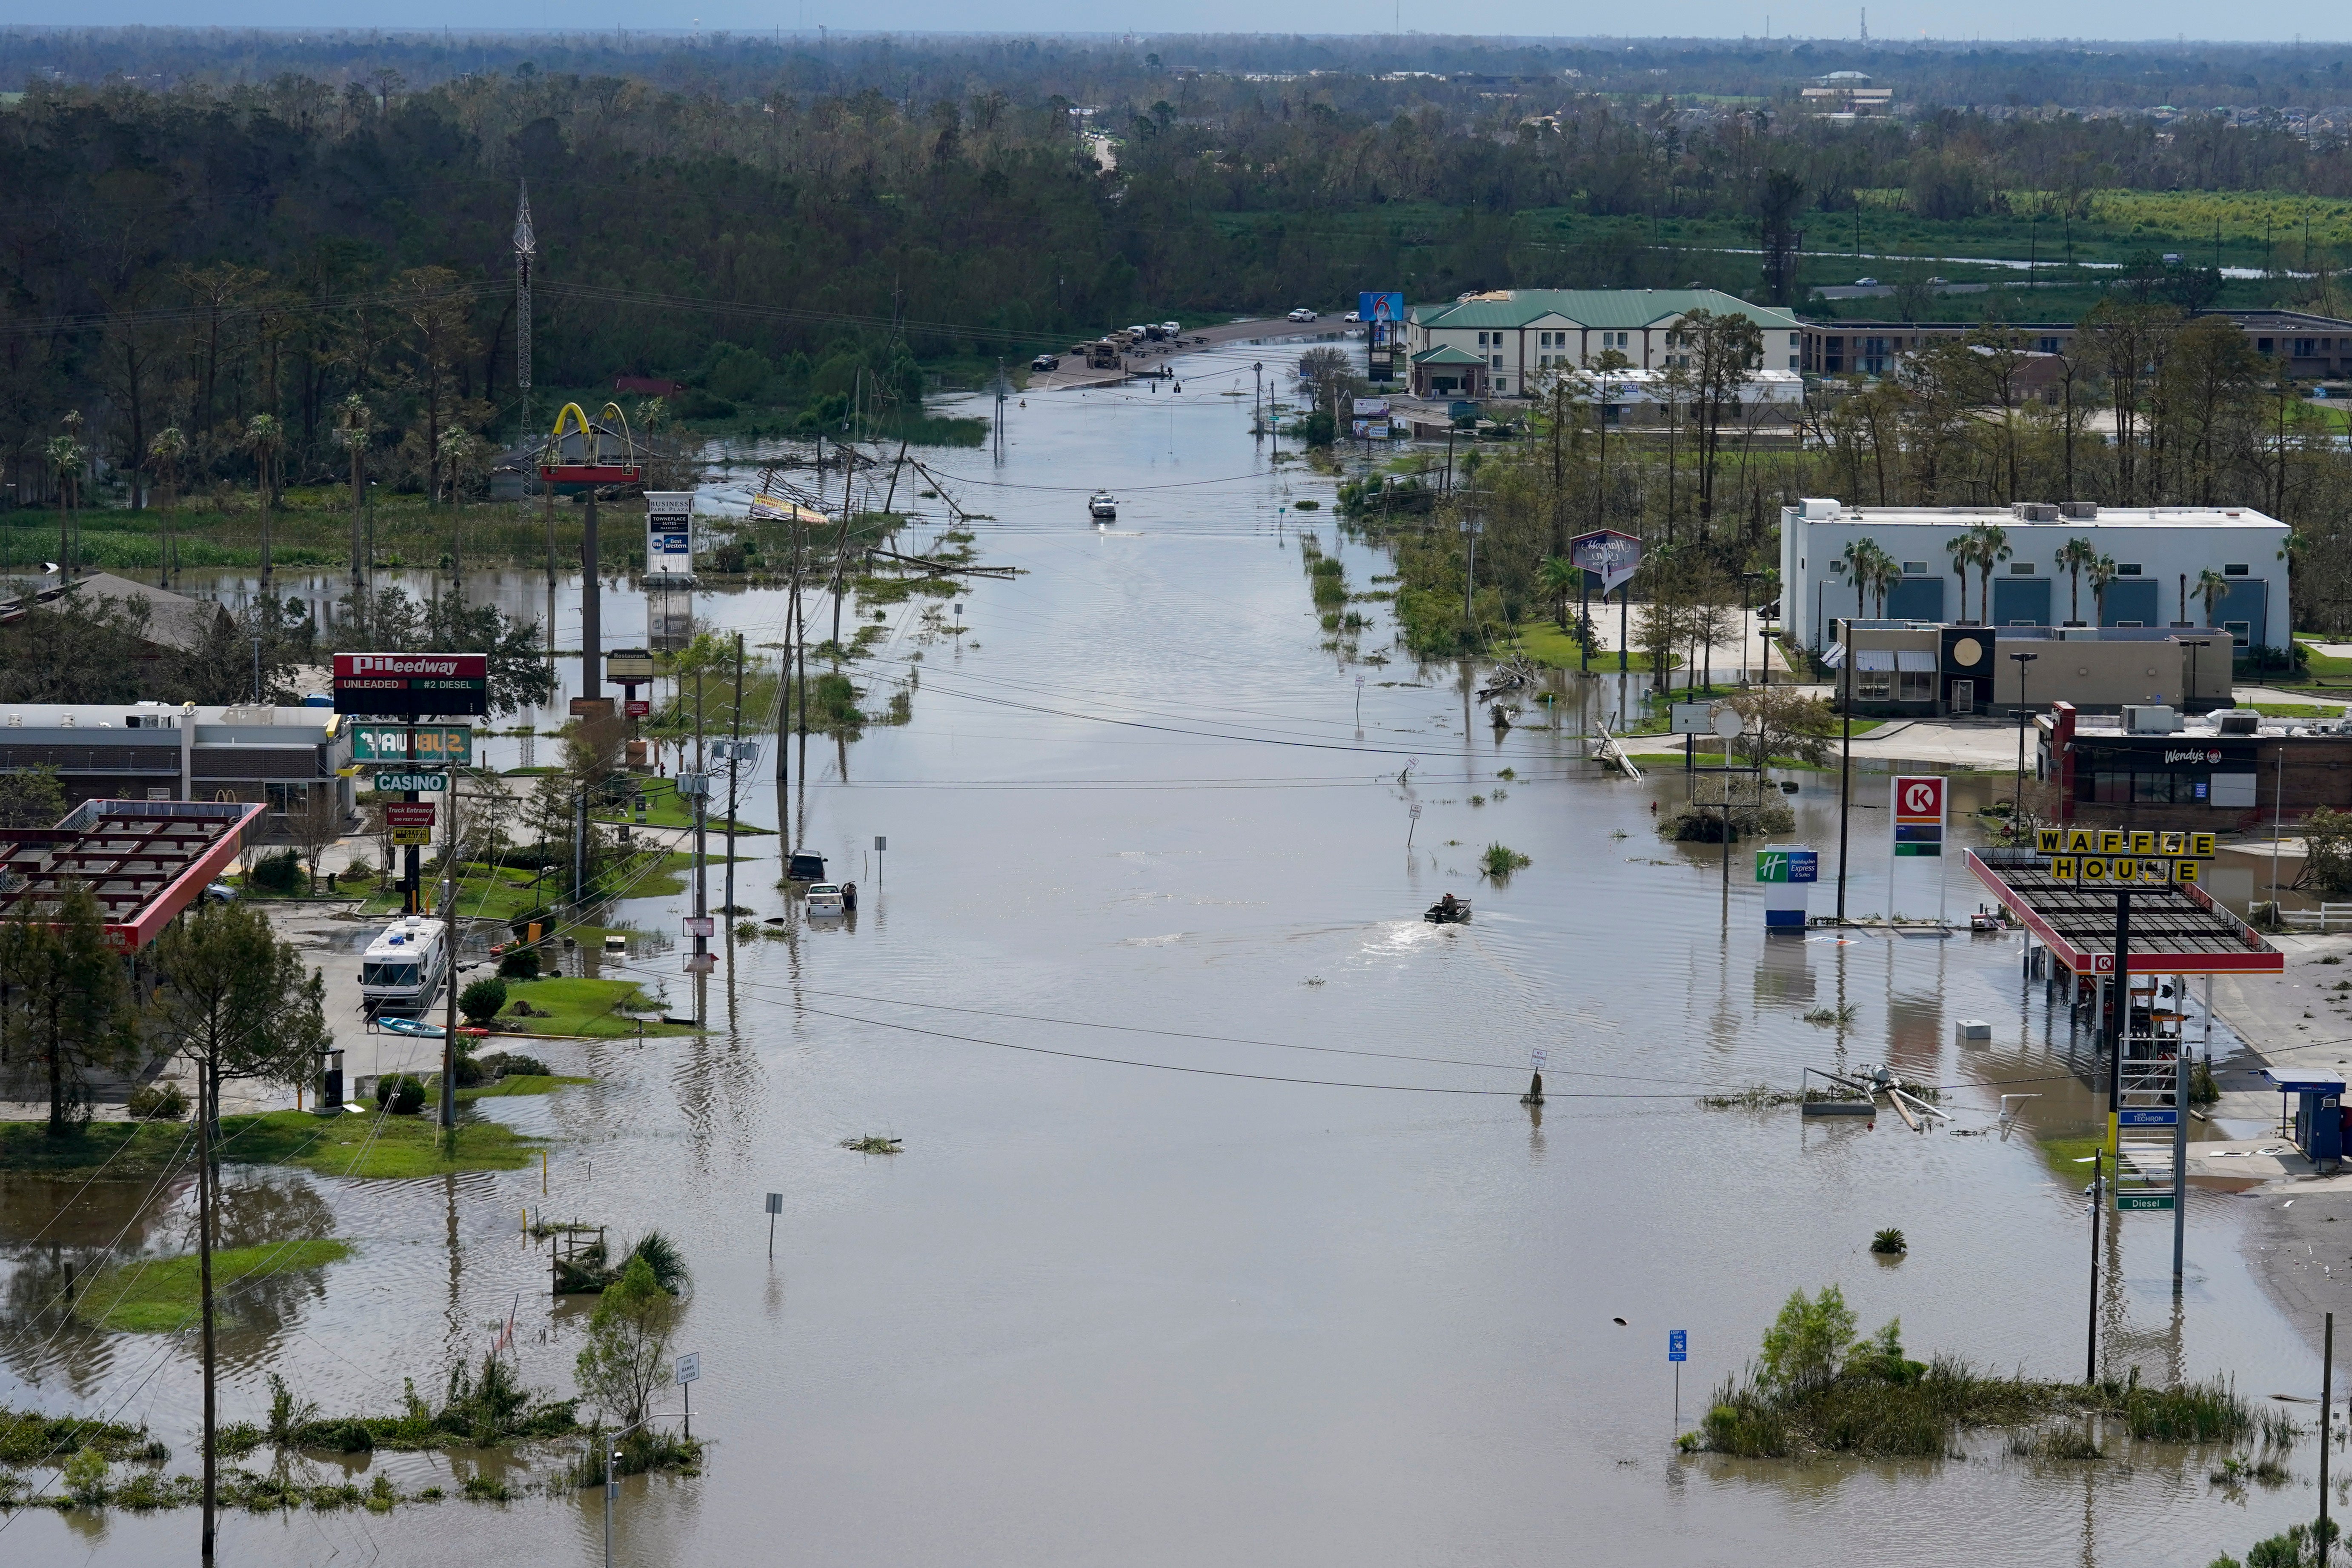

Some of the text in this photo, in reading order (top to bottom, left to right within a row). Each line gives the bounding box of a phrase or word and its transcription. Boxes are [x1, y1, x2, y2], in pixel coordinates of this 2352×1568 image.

[1374, 295, 1391, 319] 6
[343, 680, 398, 689] UNLEADED
[424, 681, 472, 689] #2 DIESEL
[2165, 748, 2204, 764] Wendy's
[379, 775, 442, 790] CASINO
[2057, 860, 2194, 880] HOUE
[681, 1372, 695, 1380] CLOSED
